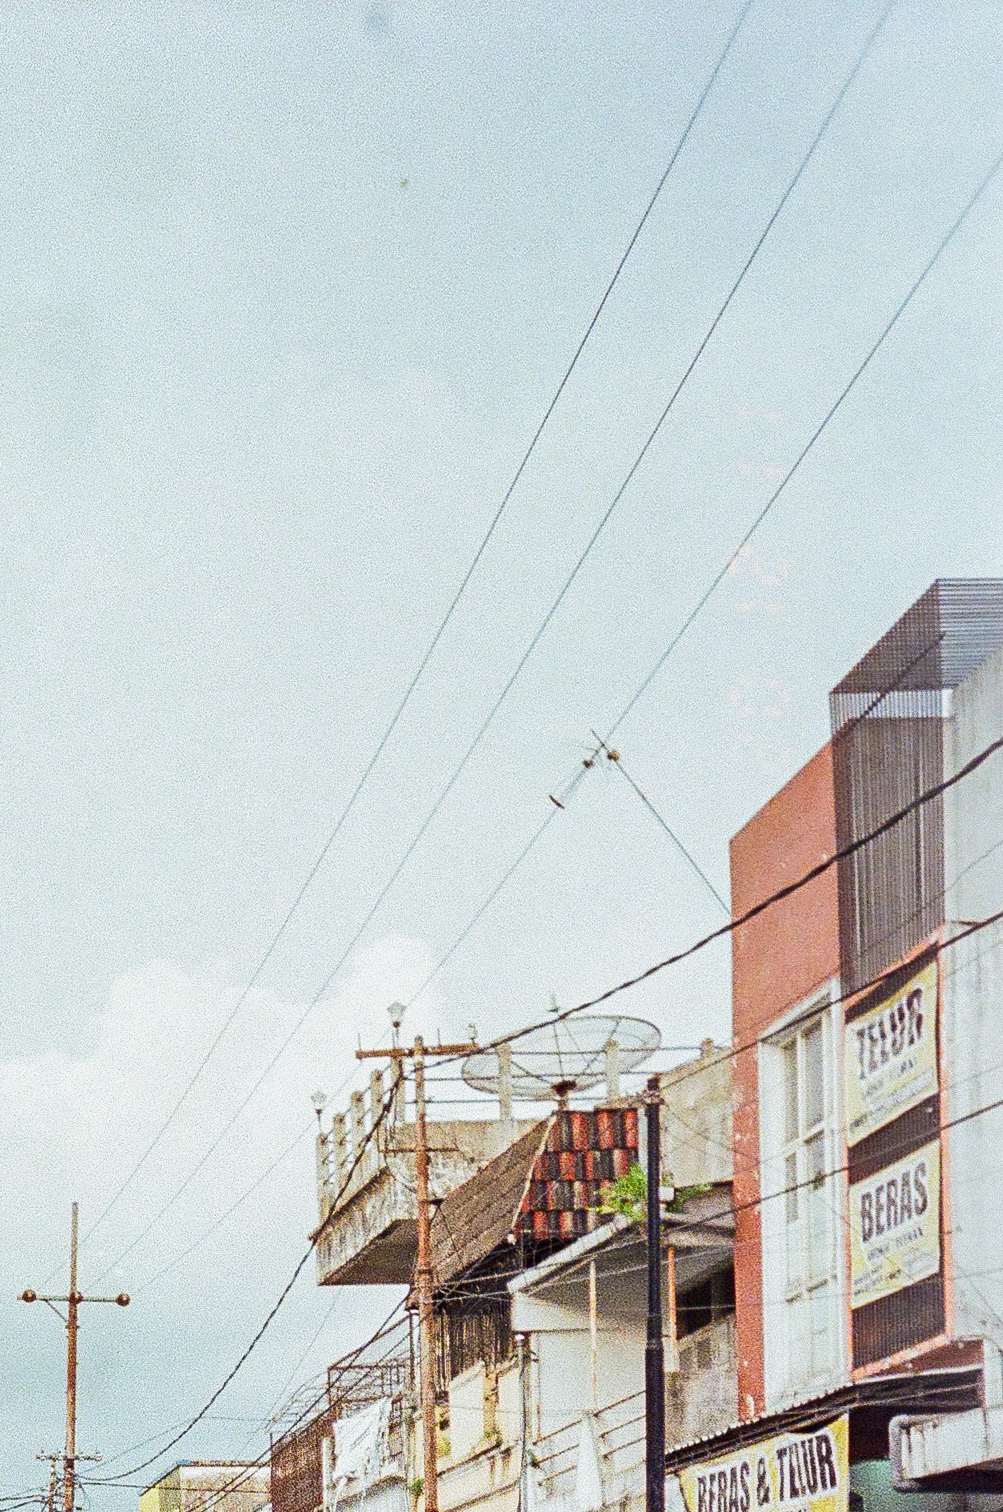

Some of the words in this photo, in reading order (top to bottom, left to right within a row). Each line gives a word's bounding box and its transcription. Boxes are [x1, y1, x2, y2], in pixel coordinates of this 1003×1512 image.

[856, 988, 923, 1080] TELUR
[860, 1162, 928, 1243] BERAS
[756, 1457, 770, 1506] &
[776, 1434, 837, 1501] TELUR
